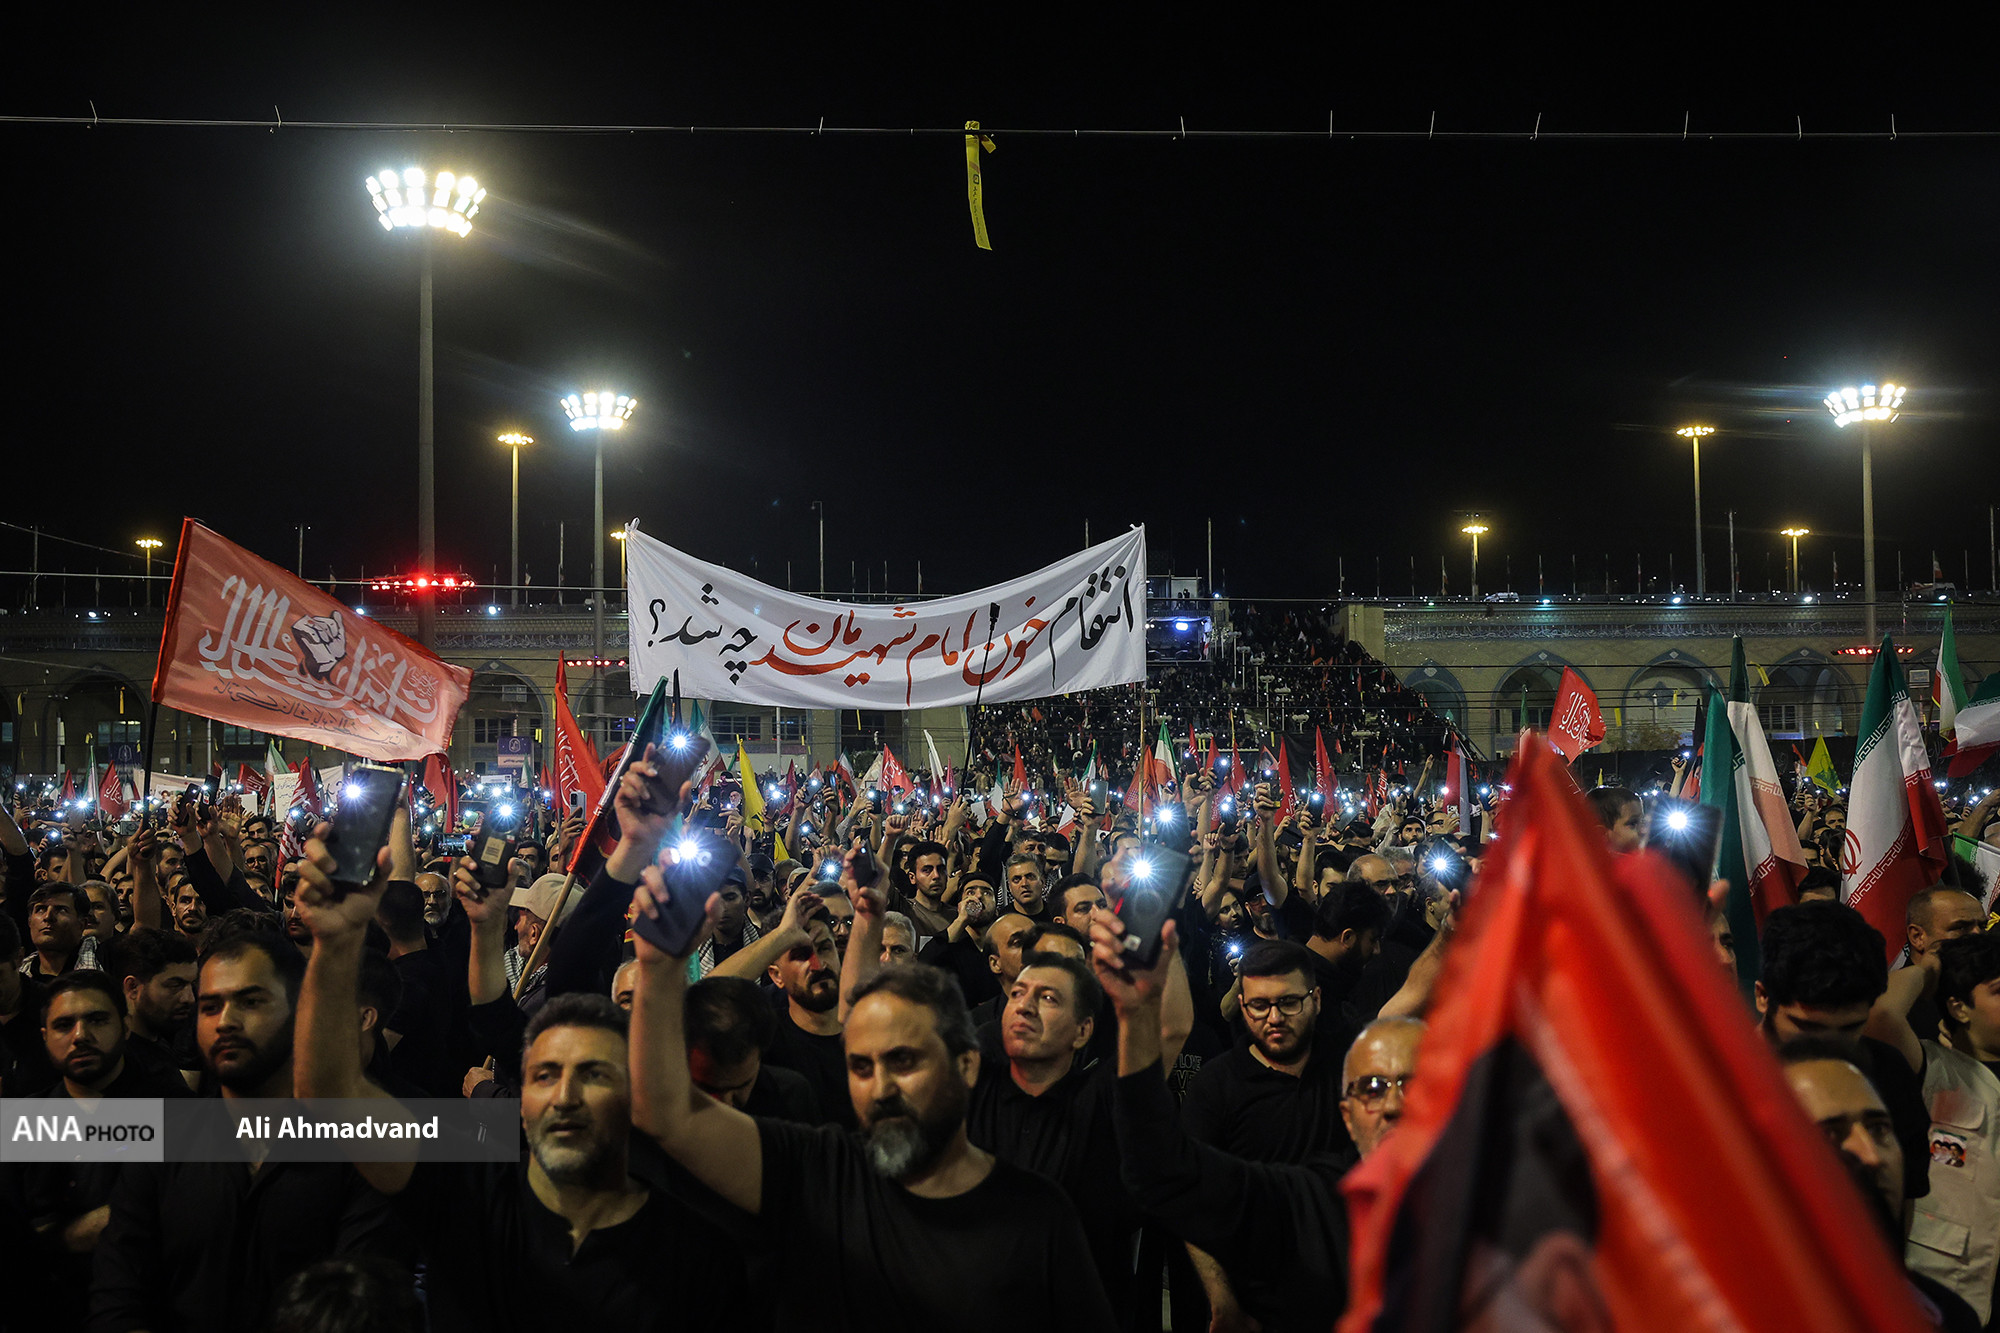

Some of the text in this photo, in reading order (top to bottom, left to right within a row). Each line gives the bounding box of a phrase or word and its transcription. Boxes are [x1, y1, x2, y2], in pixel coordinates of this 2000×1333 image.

[647, 582, 724, 648] شد؟
[717, 625, 759, 686] چه
[904, 608, 978, 708] امام
[962, 596, 1051, 688] خون
[1047, 565, 1134, 690] انتقام
